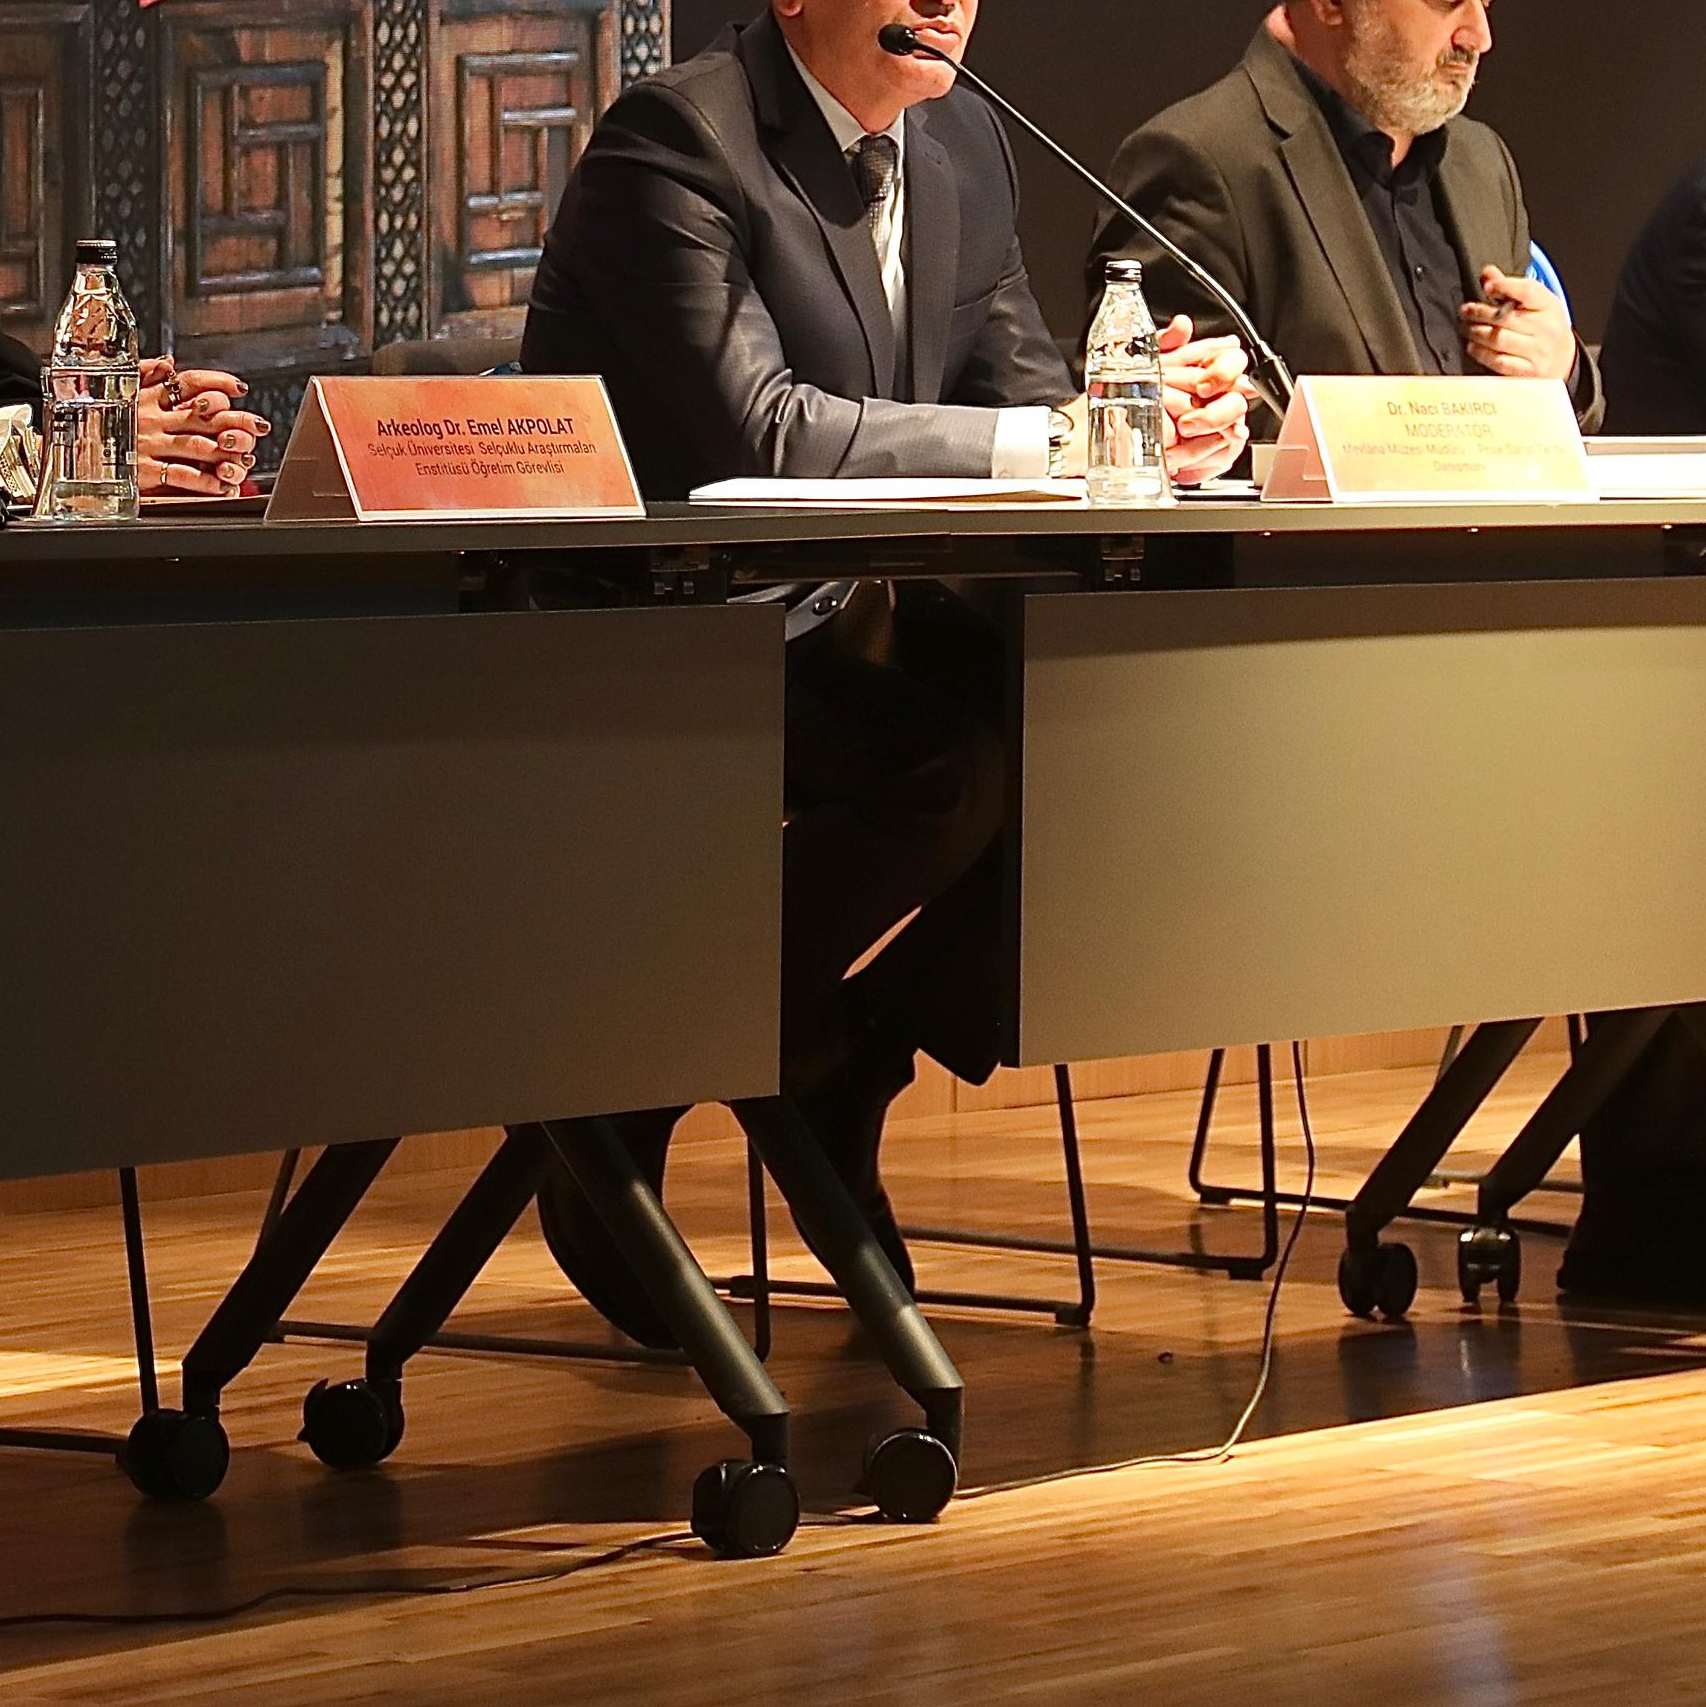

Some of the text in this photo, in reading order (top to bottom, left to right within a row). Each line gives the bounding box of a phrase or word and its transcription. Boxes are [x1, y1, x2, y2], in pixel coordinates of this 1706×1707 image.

[1387, 401, 1406, 416] Dr.
[377, 418, 575, 439] Arkeolog Dr. Emel AKPOLAT
[368, 442, 406, 460] Selçuk
[408, 440, 474, 457] Üniversitesi
[479, 441, 526, 457] Selçuklu
[415, 459, 565, 479] Enstitüsü Öğretim Görevlisi
